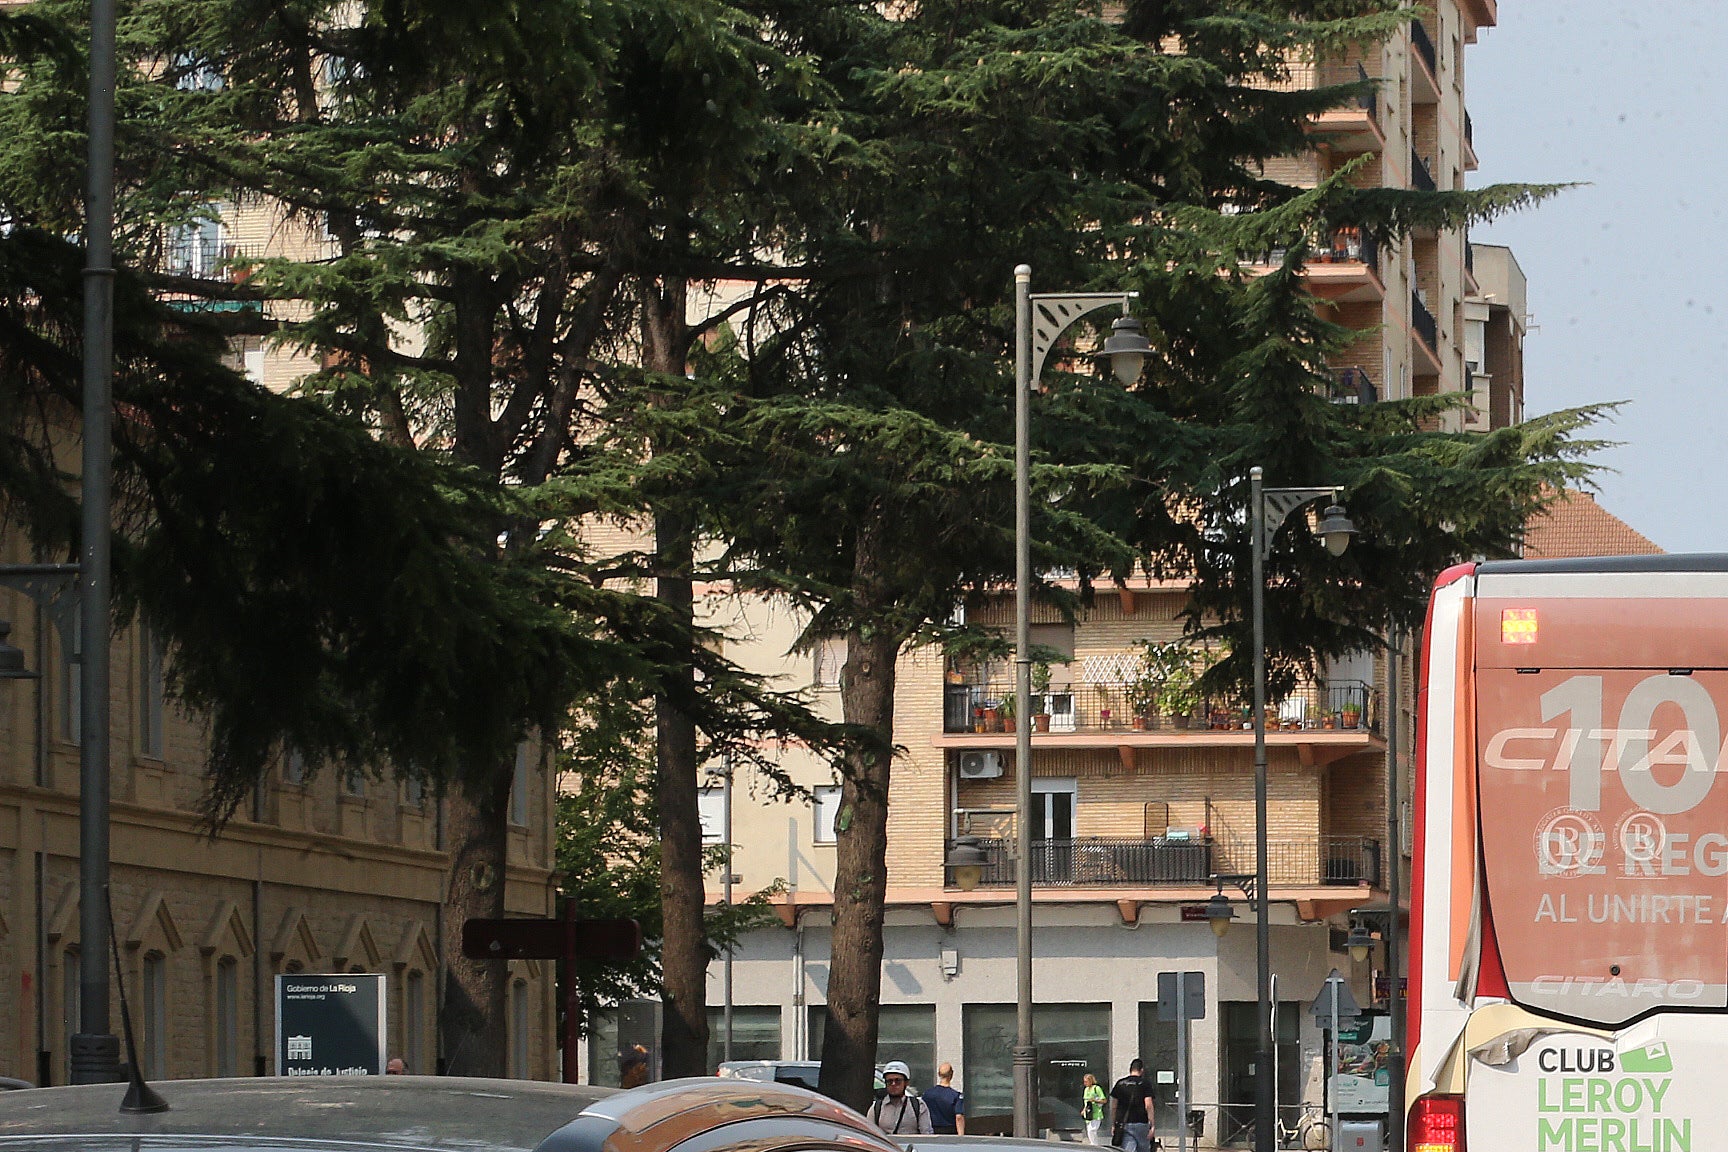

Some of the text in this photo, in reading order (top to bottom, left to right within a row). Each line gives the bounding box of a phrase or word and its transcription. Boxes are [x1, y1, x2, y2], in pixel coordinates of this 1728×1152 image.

[1538, 831, 1606, 876] DE
[1534, 893, 1577, 923] AL
[1587, 894, 1713, 924] UNIRTE
[1530, 975, 1705, 1001] CITARO
[1538, 1048, 1615, 1073] CLUB
[1537, 1077, 1672, 1114] LEROY
[1537, 1117, 1692, 1152] MERLIN
